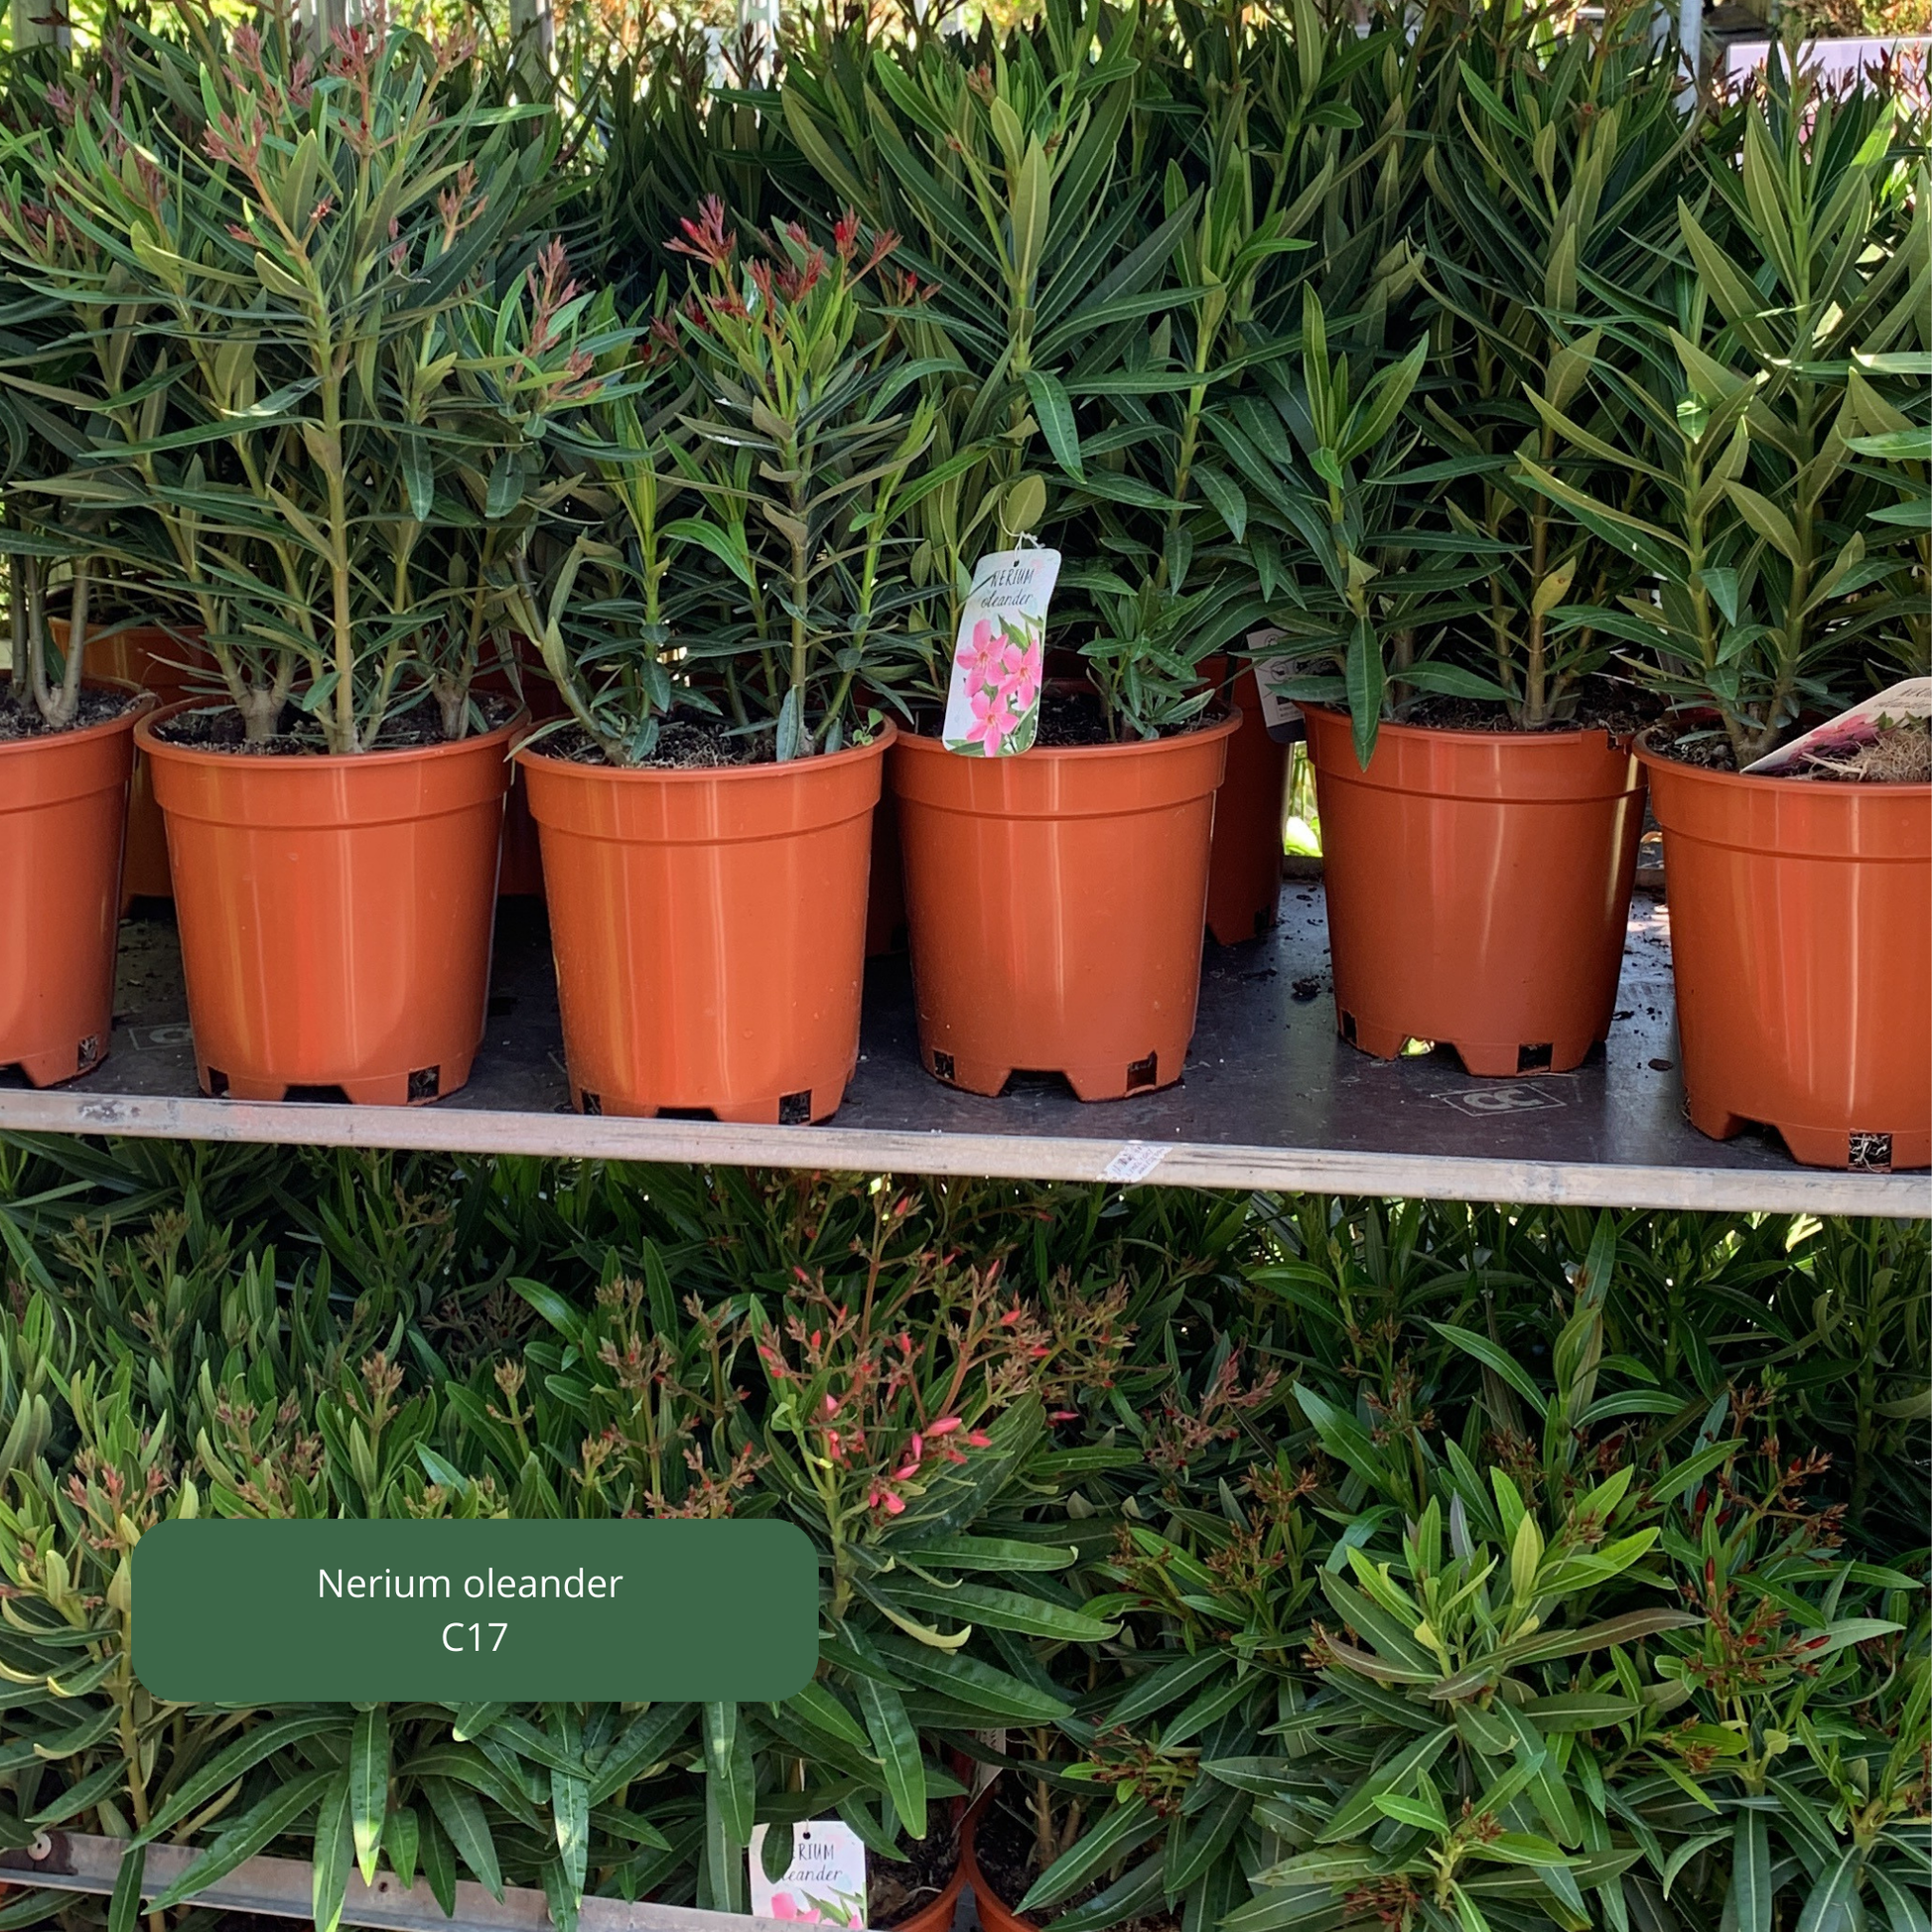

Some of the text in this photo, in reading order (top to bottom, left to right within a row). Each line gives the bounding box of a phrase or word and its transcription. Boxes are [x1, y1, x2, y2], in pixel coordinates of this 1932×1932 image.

[990, 568, 1035, 588] NERIUM
[980, 589, 1034, 609] oleander
[793, 1843, 834, 1862] RIUM
[782, 1864, 843, 1881] eander
